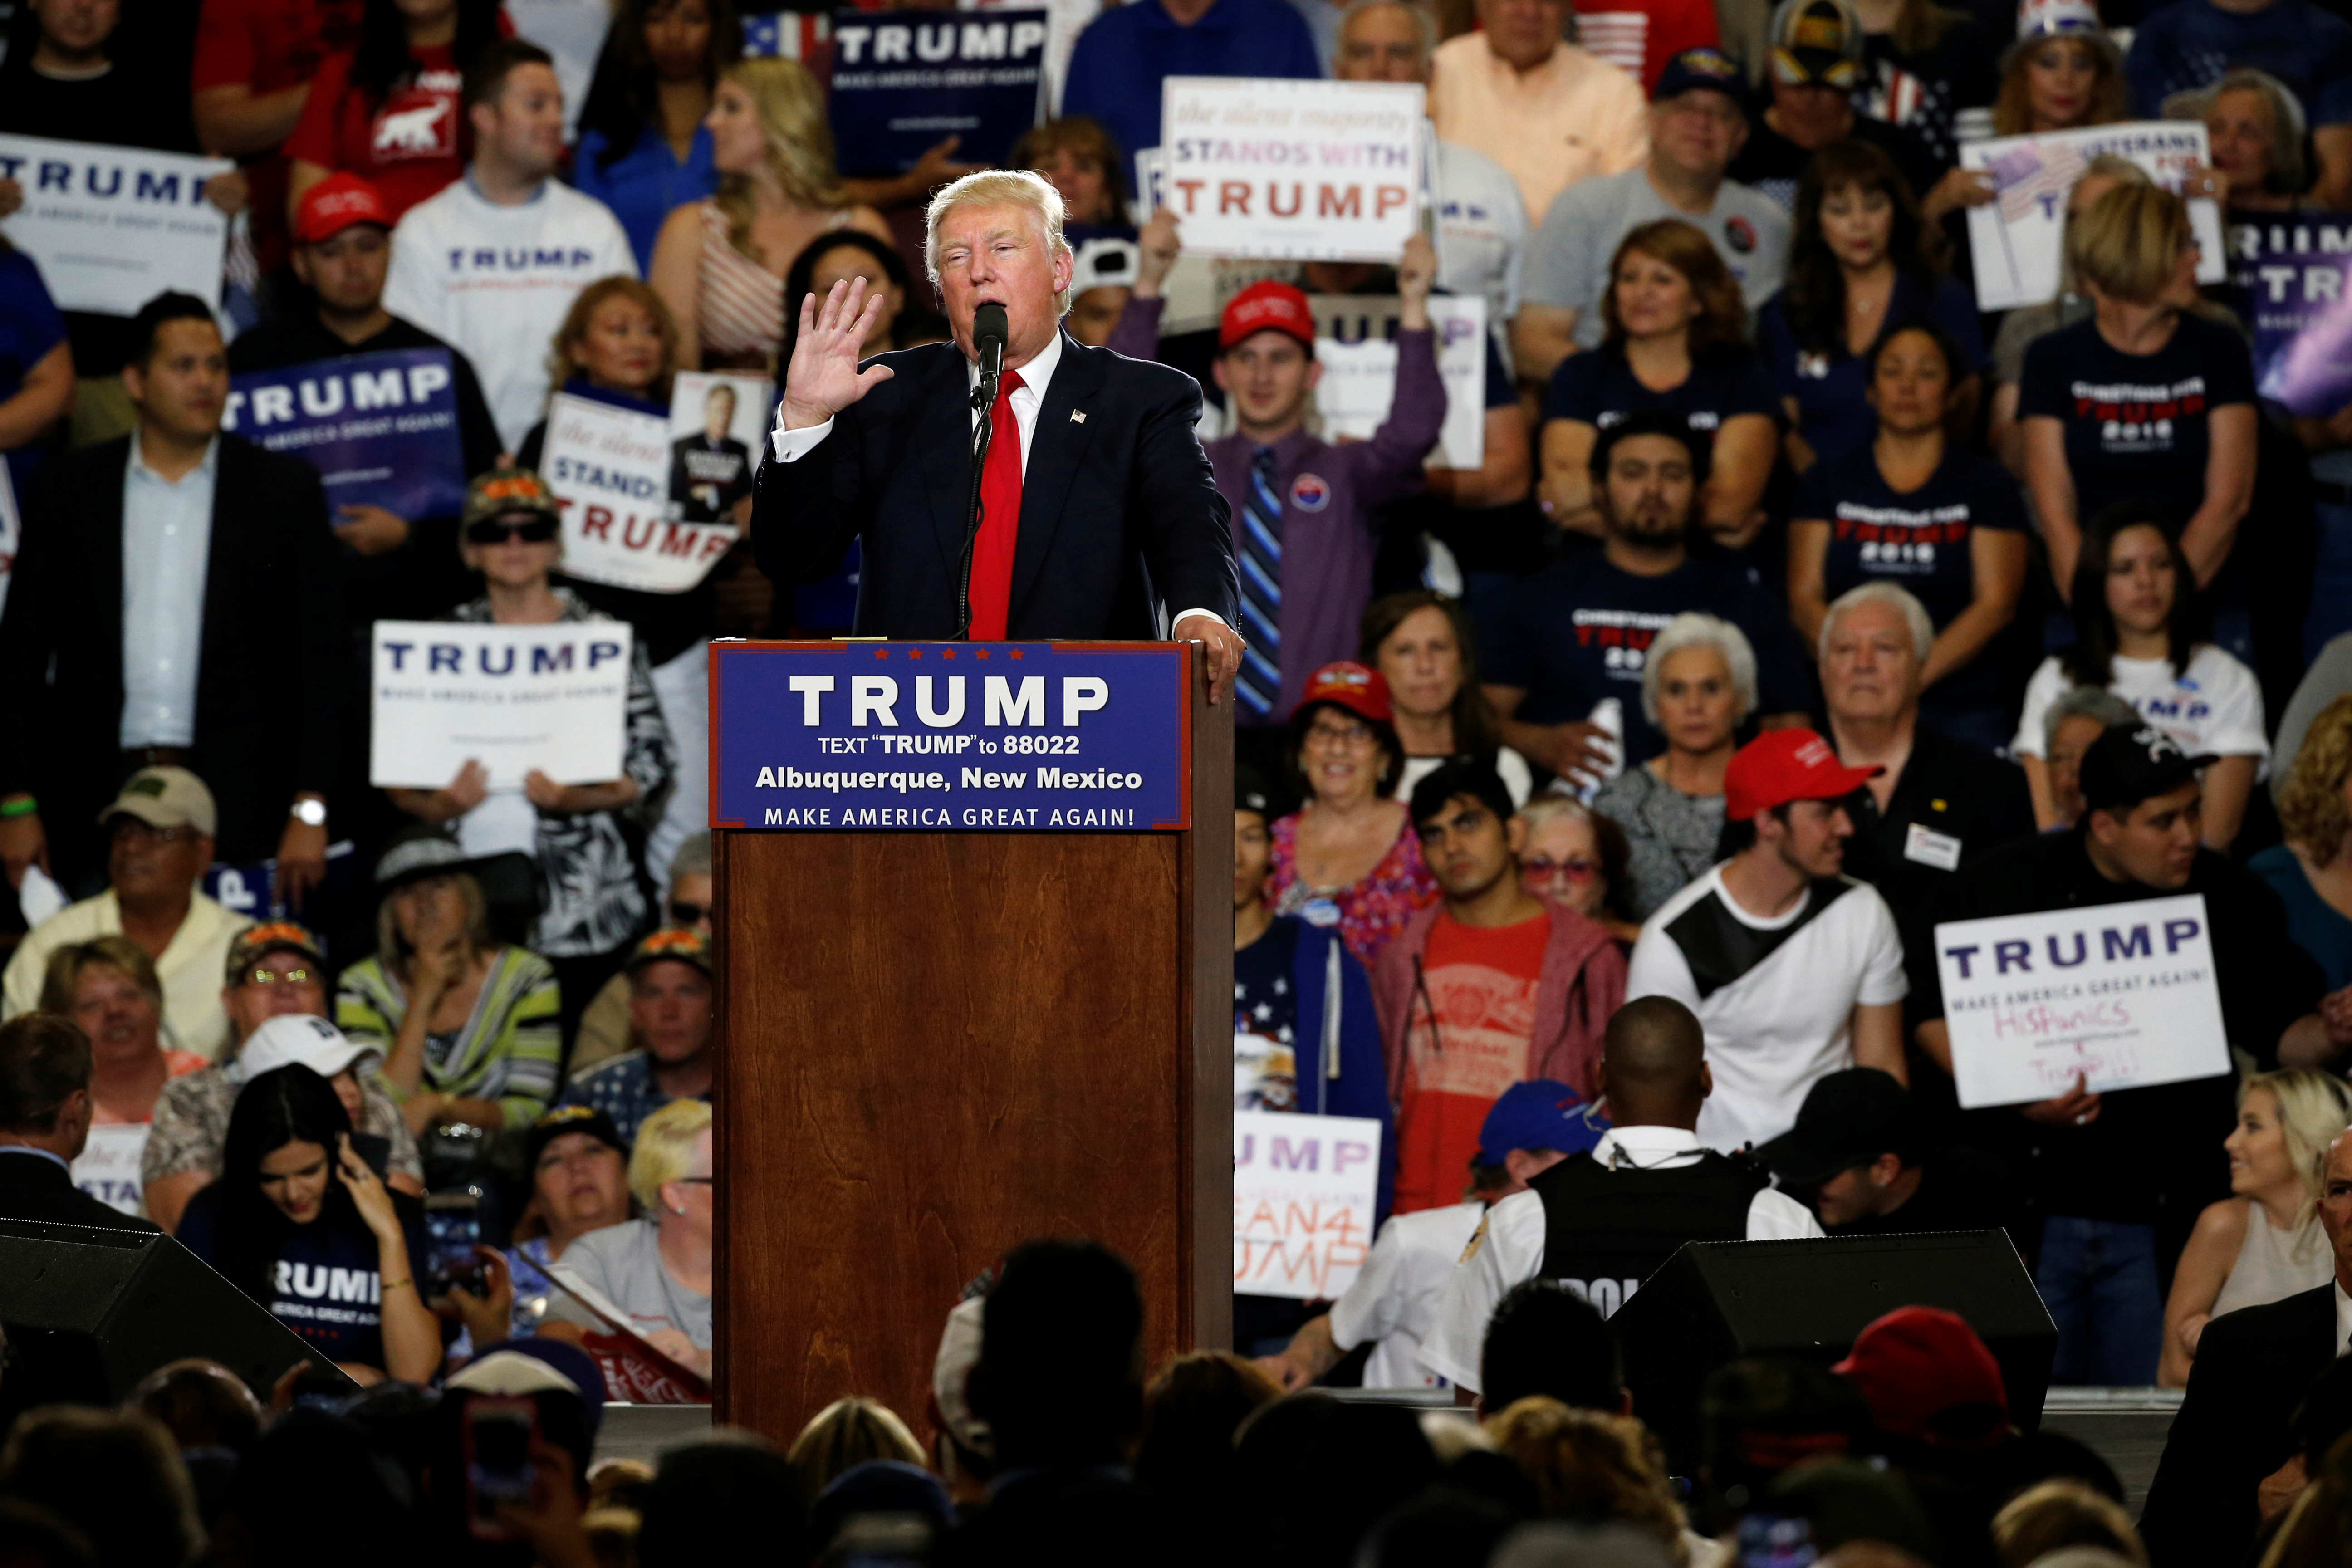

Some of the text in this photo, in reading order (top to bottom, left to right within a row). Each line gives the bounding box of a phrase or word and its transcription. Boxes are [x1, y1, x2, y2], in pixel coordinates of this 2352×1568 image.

[835, 21, 1045, 63] TRUMP
[1176, 138, 1310, 166] STANDS
[1319, 140, 1409, 167] WITH
[1176, 180, 1410, 221] TRUMP
[446, 246, 593, 272] TRUMP
[383, 642, 622, 676] TRUMP
[789, 676, 1108, 728] TRUMP
[818, 738, 868, 754] TEXT
[979, 739, 997, 754] to
[1003, 735, 1079, 755] 88022
[755, 766, 1142, 793] Albuquerque, New Mexico
[764, 808, 1133, 826] MAKE AMERICA GREAT AGAIN!
[1946, 918, 2200, 980] TRUMP
[1951, 992, 1998, 1012] MAKE
[2005, 985, 2082, 1006] AMERICA
[2089, 975, 2141, 996] GREAT
